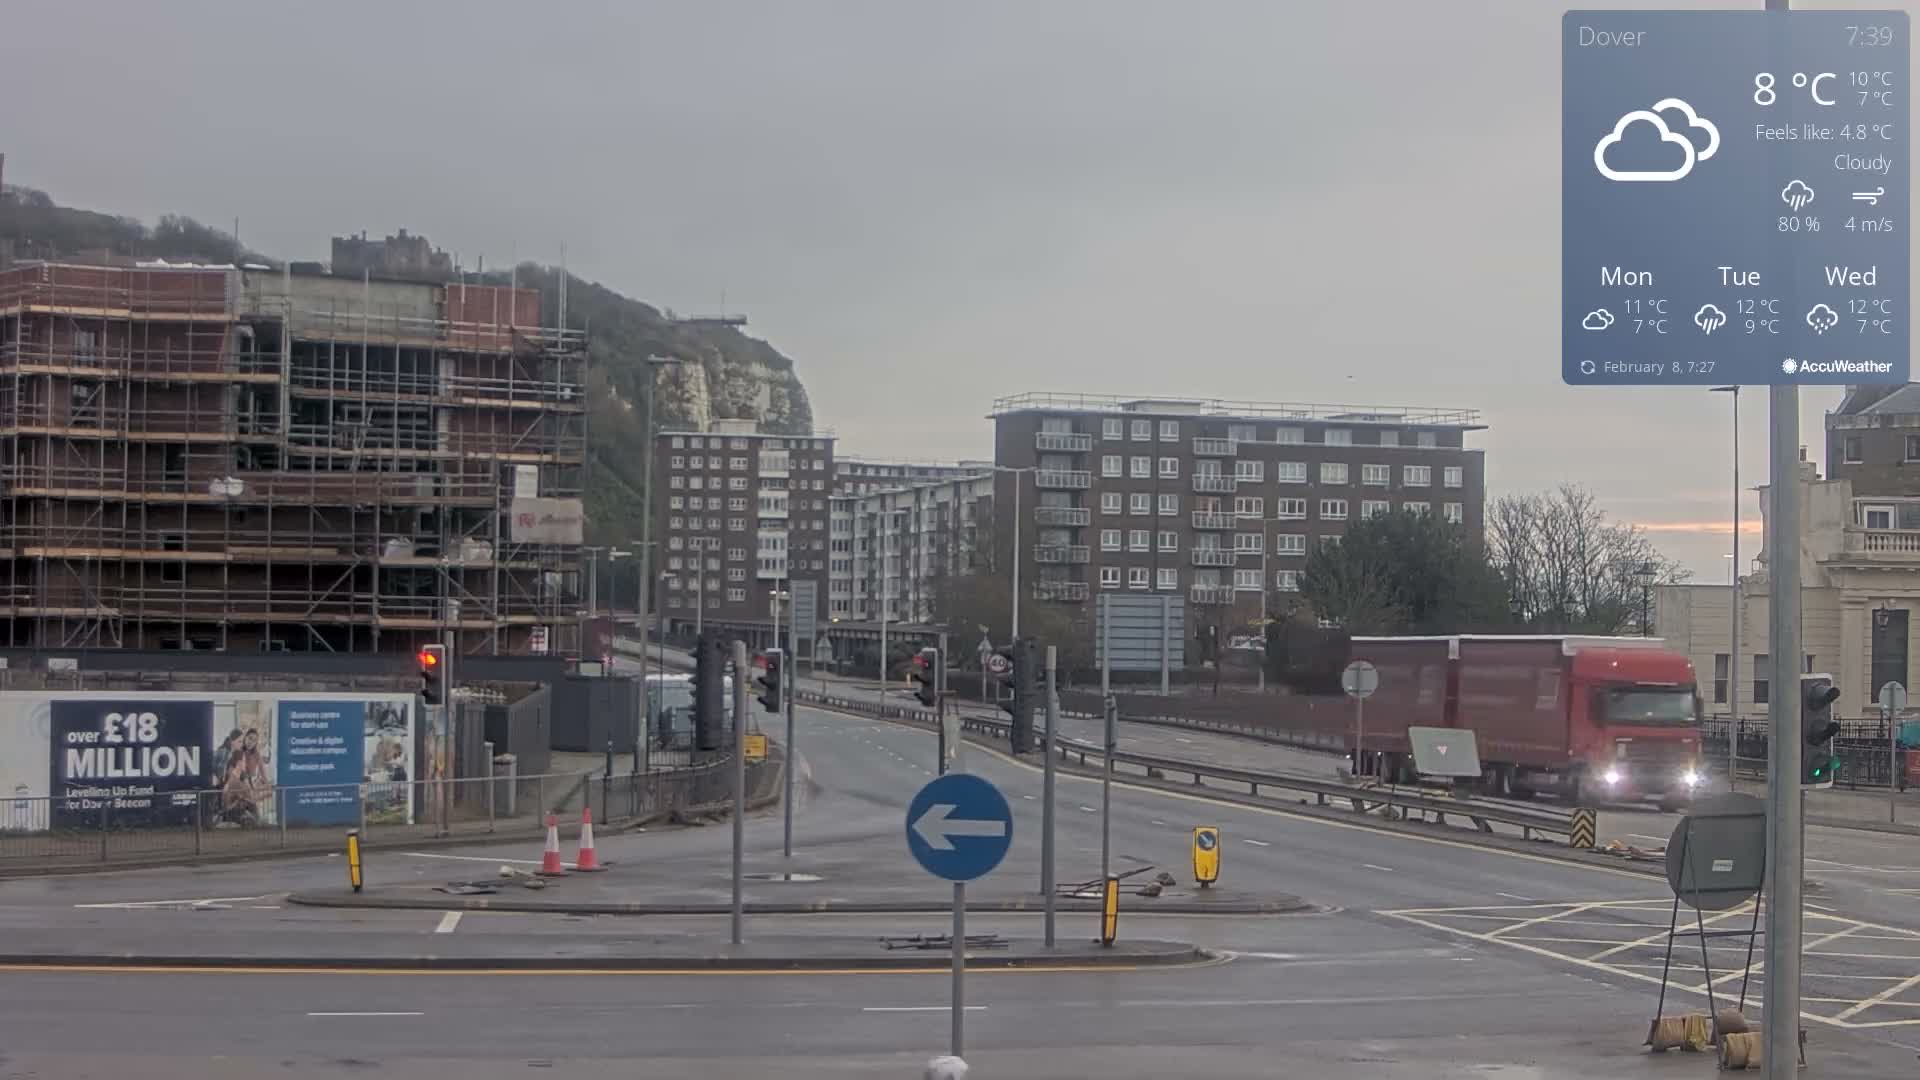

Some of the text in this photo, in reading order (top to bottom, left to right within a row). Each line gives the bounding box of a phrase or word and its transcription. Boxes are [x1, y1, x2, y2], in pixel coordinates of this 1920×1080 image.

[991, 658, 1006, 667] 40
[67, 712, 159, 743] over £18
[66, 746, 201, 779] MILLION
[112, 786, 127, 798] Up
[129, 785, 155, 796] Fund
[82, 799, 112, 810] Dovr
[114, 797, 152, 809] Beacon
